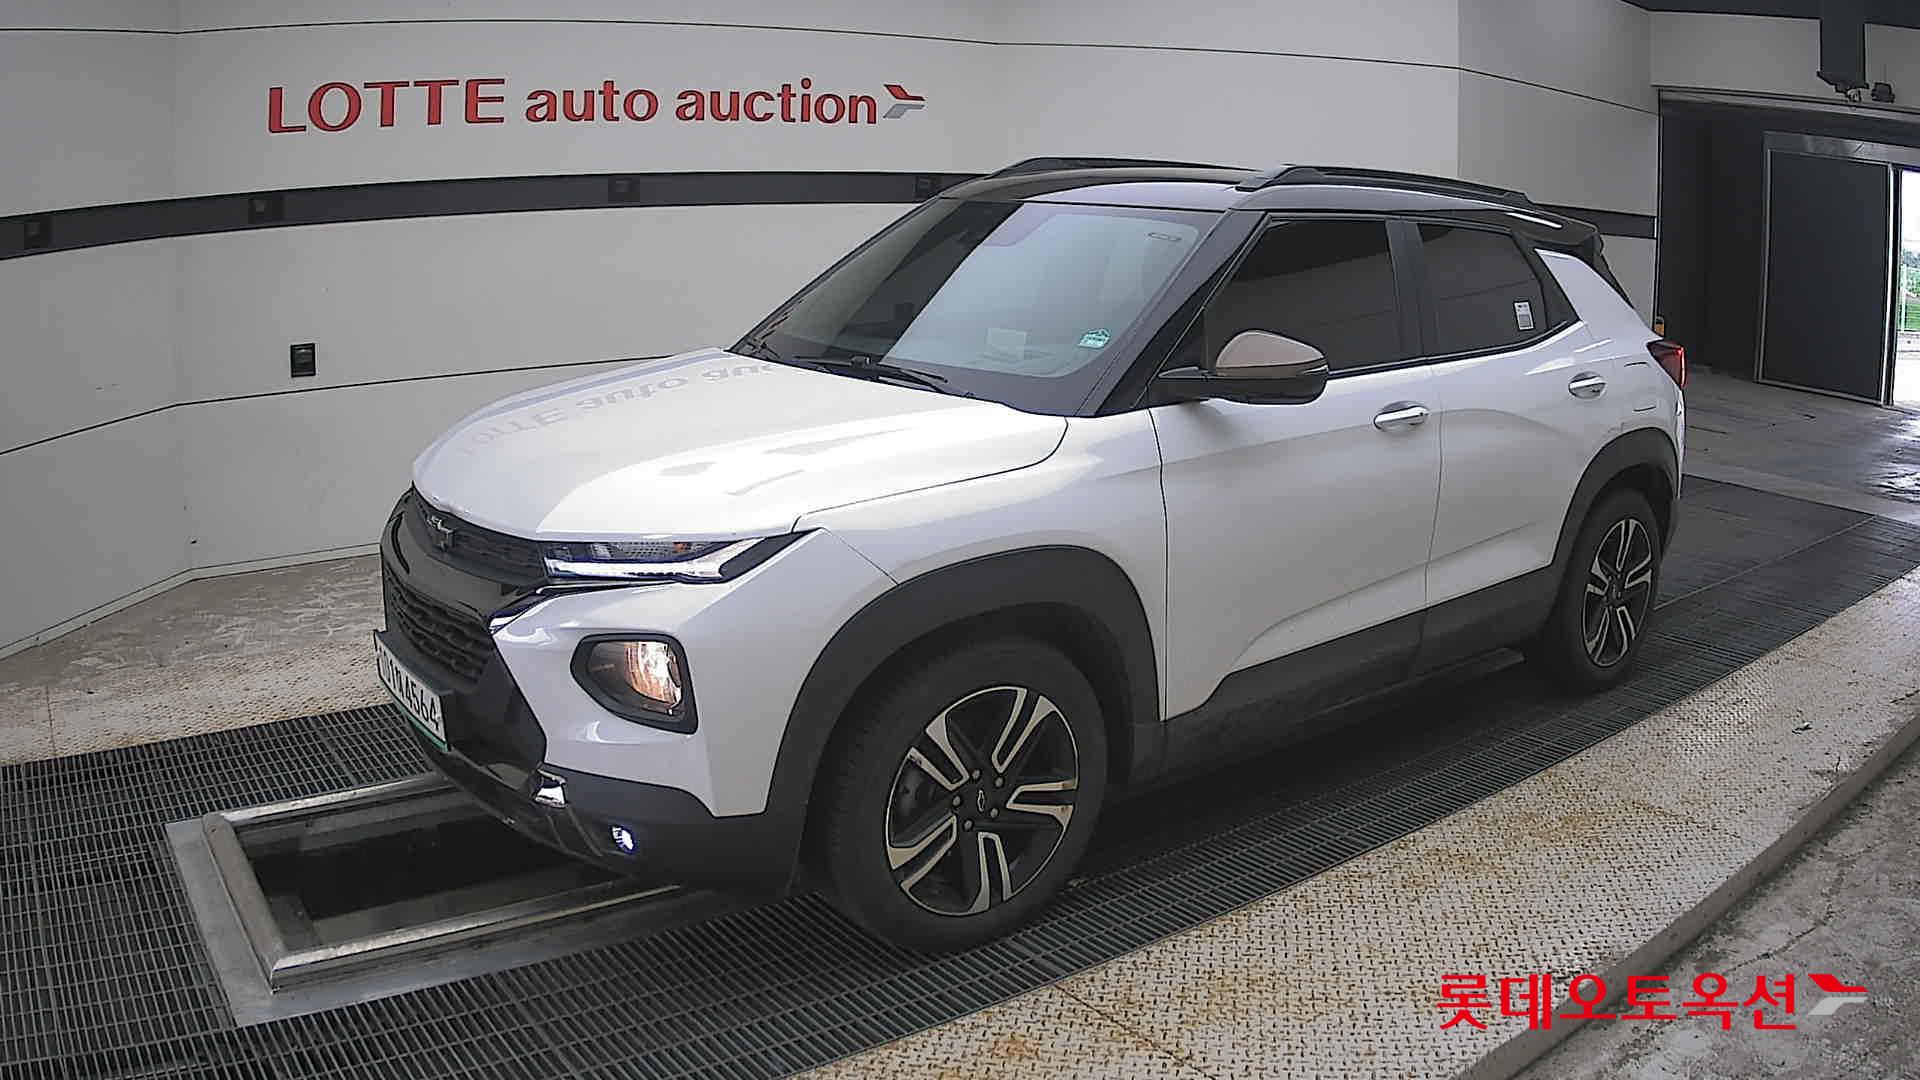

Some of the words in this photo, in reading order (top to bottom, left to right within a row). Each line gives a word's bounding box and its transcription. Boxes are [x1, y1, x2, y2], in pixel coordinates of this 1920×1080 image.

[267, 78, 506, 133] LOTTE
[525, 80, 660, 122] auto
[674, 77, 878, 125] auction
